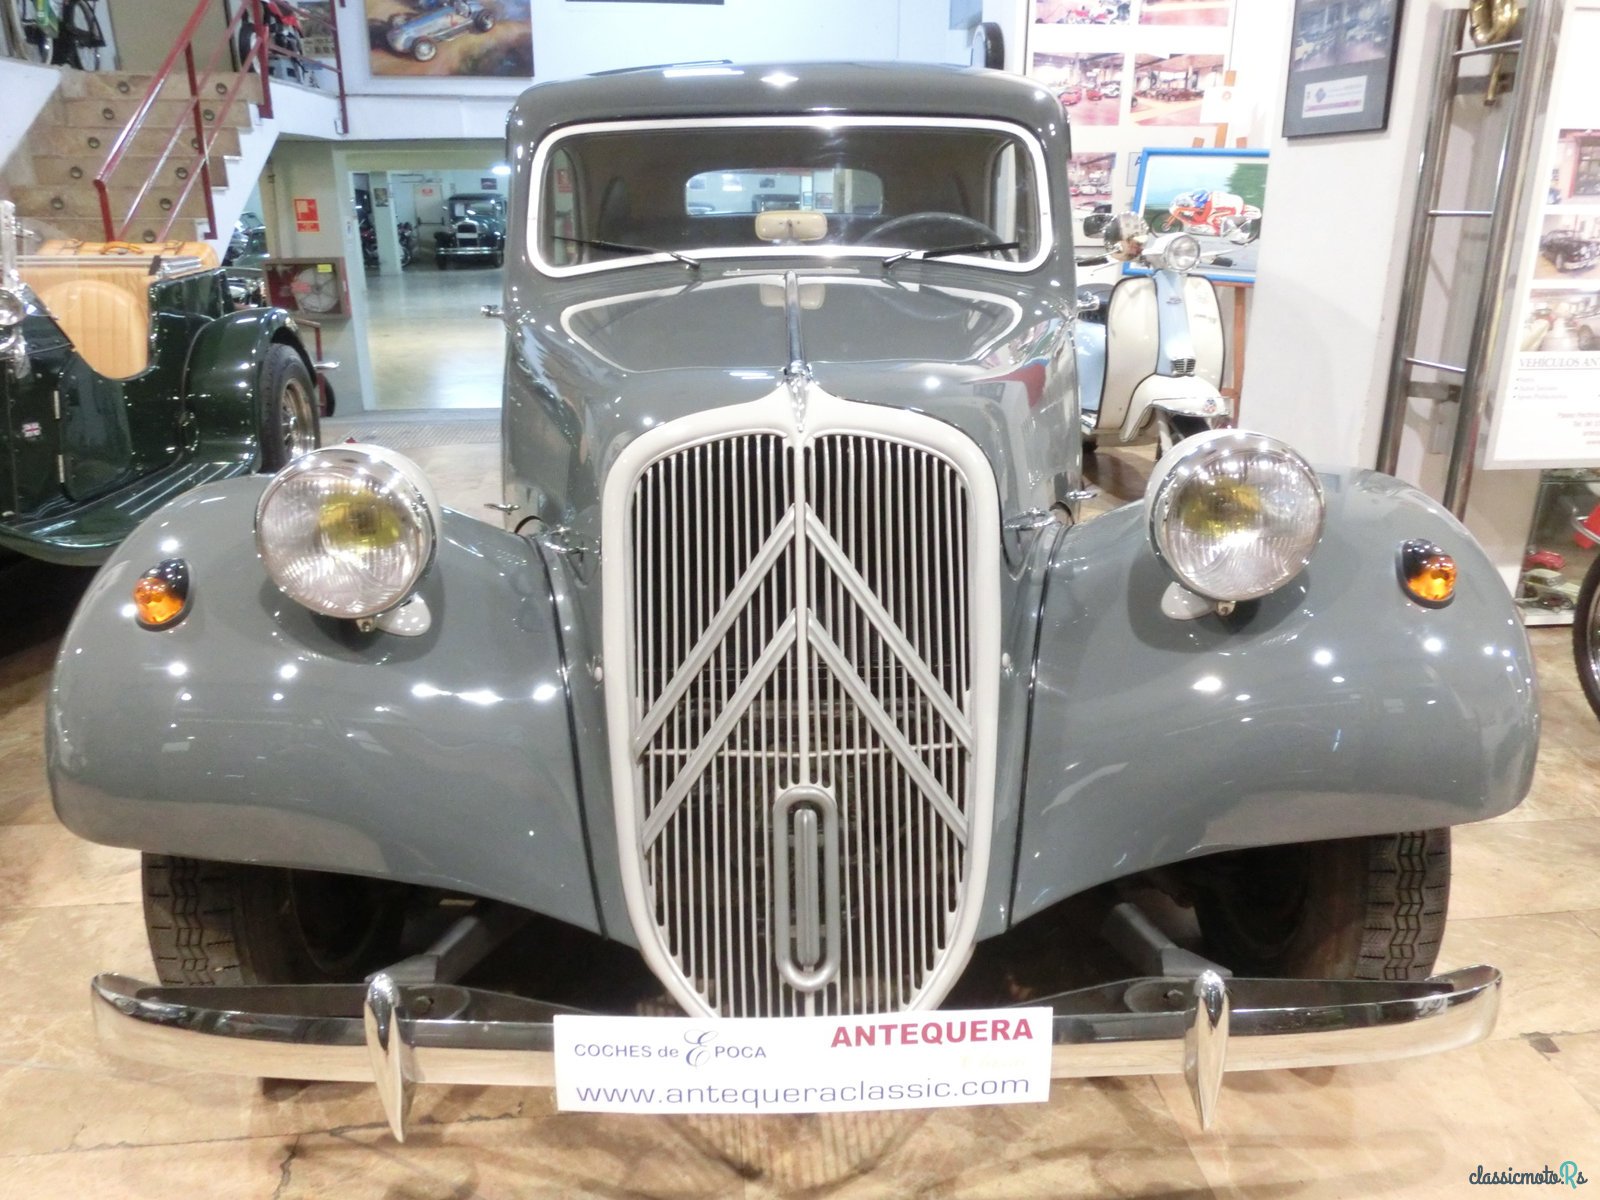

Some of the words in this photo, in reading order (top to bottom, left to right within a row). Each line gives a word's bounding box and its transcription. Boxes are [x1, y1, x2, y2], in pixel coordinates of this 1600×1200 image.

[831, 1018, 1034, 1049] ANTEQUERA
[574, 1043, 652, 1058] COCHES
[657, 1045, 679, 1058] de
[576, 1076, 1030, 1109] www.antequeraclassic.com
